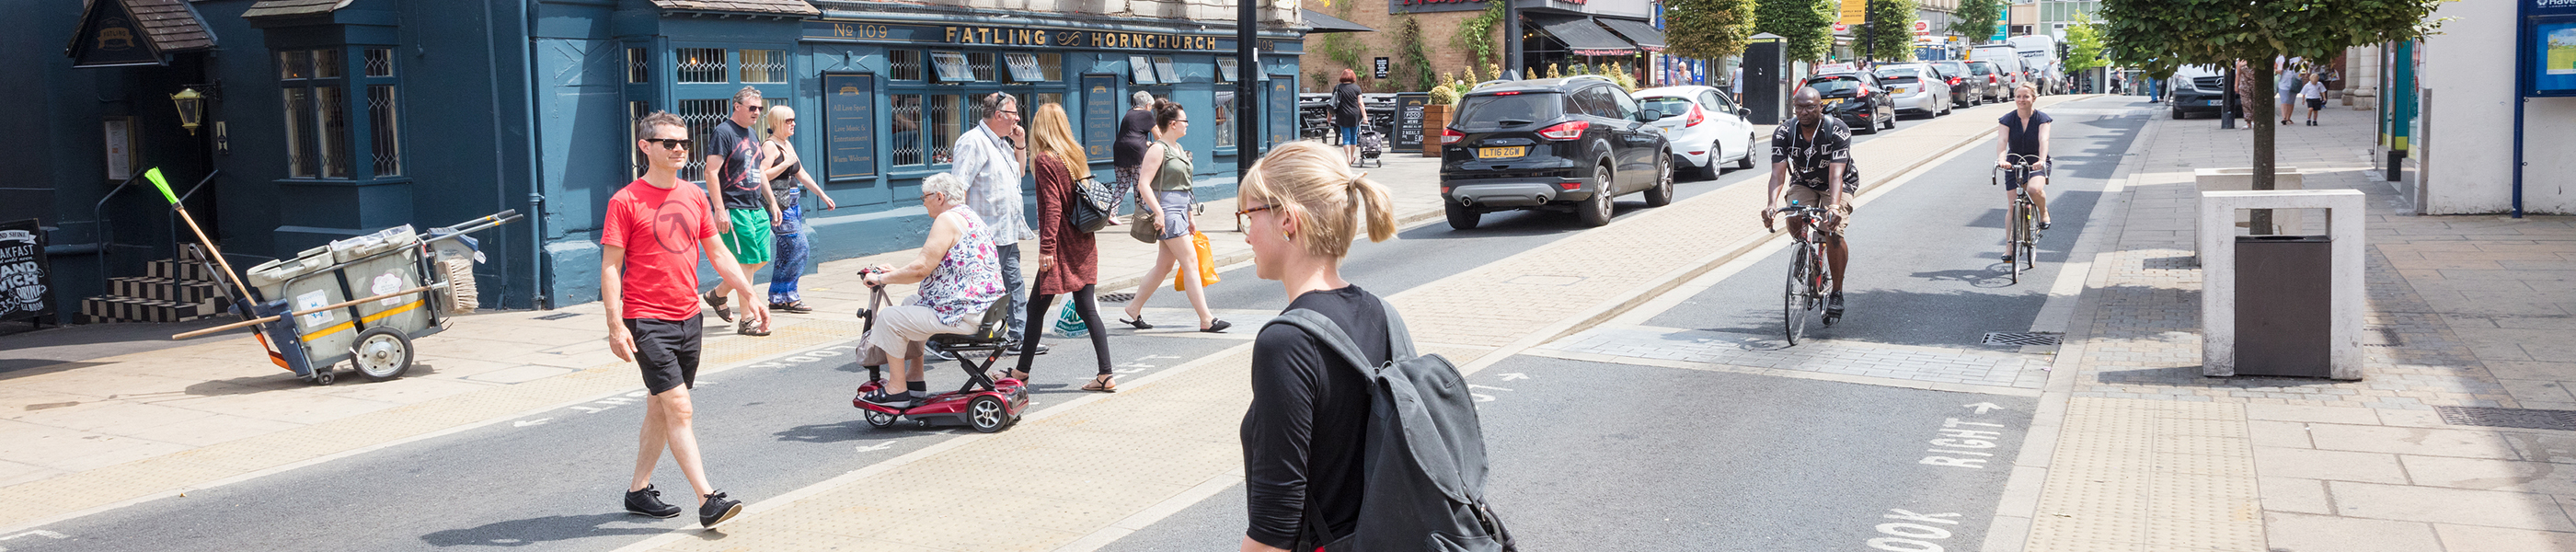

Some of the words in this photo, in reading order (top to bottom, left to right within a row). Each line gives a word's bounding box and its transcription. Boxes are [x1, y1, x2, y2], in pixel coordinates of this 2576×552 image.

[859, 24, 888, 39] 109
[945, 27, 1046, 45] FATLING
[1091, 32, 1215, 50] HORNCHURCH
[1258, 40, 1273, 51] 109
[854, 104, 867, 112] Sport
[834, 134, 868, 143] Entertainment
[1483, 148, 1501, 156] LT16
[1503, 147, 1519, 155] ZGW
[16, 284, 41, 300] DRINK
[29, 300, 44, 312] NOON
[1919, 418, 2005, 469] RIGHT
